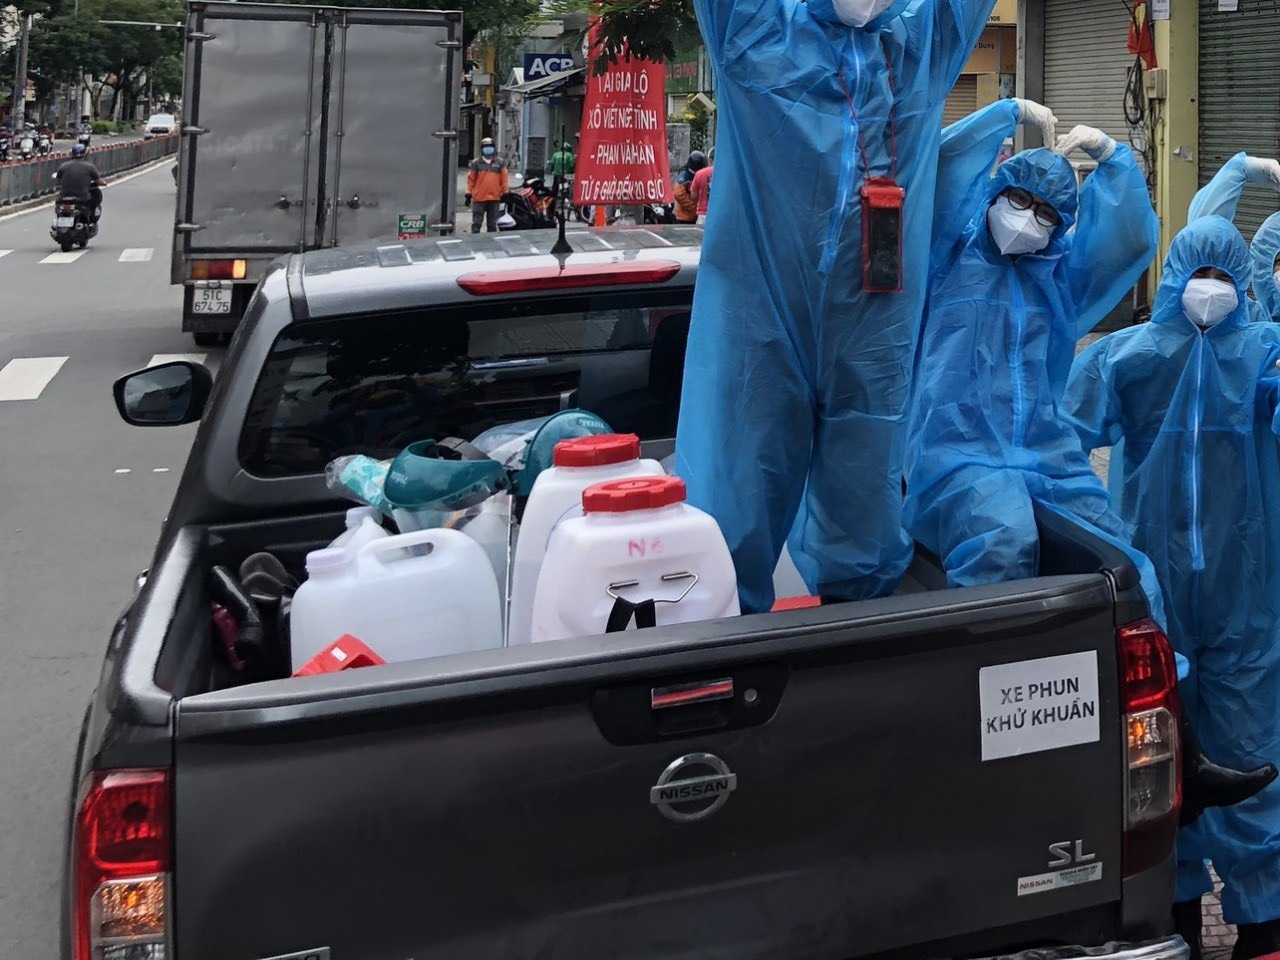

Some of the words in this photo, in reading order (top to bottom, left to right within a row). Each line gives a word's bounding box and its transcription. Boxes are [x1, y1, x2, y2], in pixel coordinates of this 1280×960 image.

[587, 105, 601, 129] XÔ
[581, 175, 592, 200] TỪ
[648, 175, 665, 199] GIỜ
[400, 220, 424, 228] CRB
[203, 290, 222, 301] 51C
[1001, 686, 1023, 705] XE
[1028, 677, 1079, 700] PHUN
[987, 707, 1027, 734] KHỬ
[660, 780, 728, 800] NISSAN
[1048, 839, 1096, 868] SL
[1020, 878, 1054, 890] NISSAN
